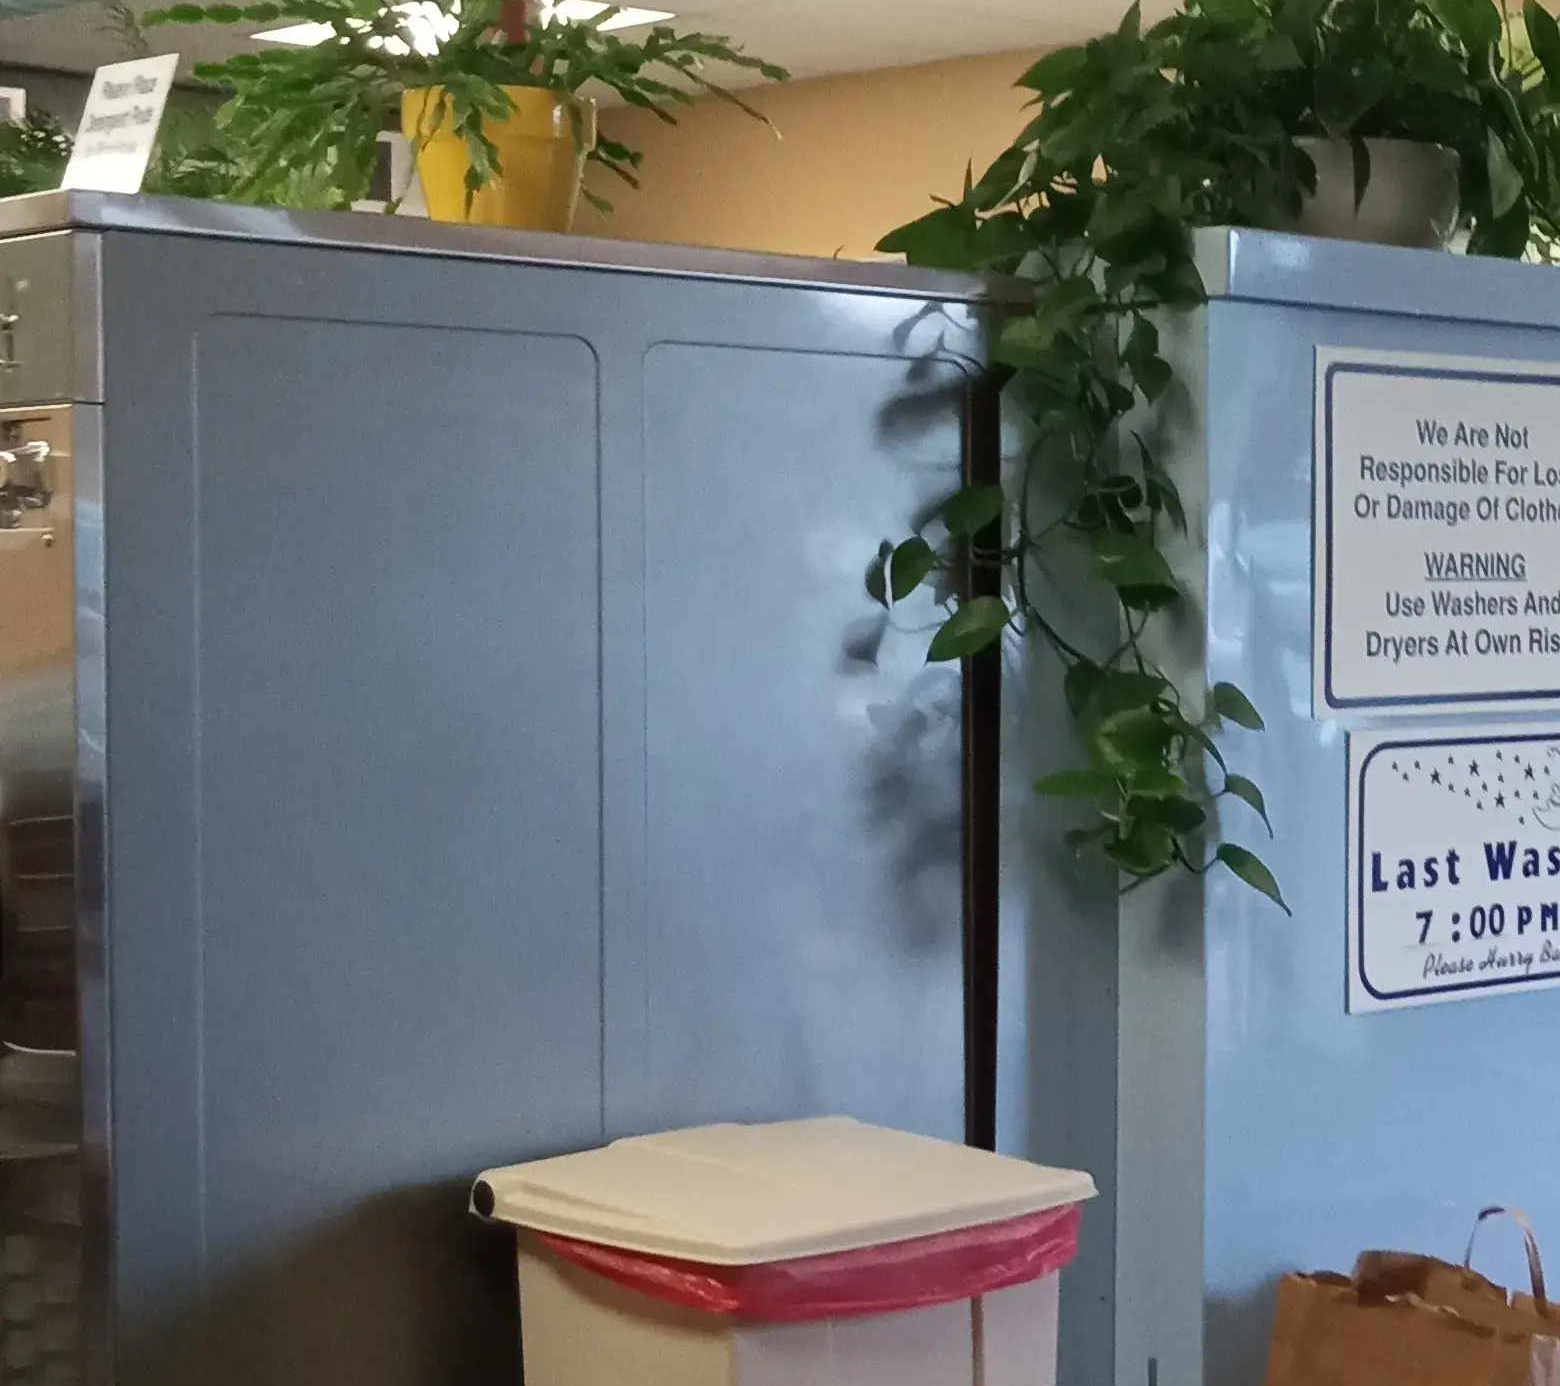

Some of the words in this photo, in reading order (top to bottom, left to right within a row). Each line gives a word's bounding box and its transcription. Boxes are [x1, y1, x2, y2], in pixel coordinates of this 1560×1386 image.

[1415, 419, 1448, 446] We
[1453, 421, 1489, 447] Are
[1494, 423, 1530, 449] Not
[1359, 455, 1489, 488] Responsible
[1494, 460, 1528, 485] For
[1353, 493, 1381, 518] Or
[1386, 493, 1471, 526] Damage
[1476, 497, 1500, 521] Of
[1424, 552, 1527, 580] WARNING
[1385, 591, 1425, 617] Use
[1431, 590, 1518, 617] Washers
[1365, 631, 1439, 664] Dryers
[1445, 629, 1468, 656] At
[1475, 629, 1522, 655] Own
[1370, 848, 1460, 892] Last
[1422, 952, 1474, 979] Please
[1478, 946, 1534, 975] Hurry
